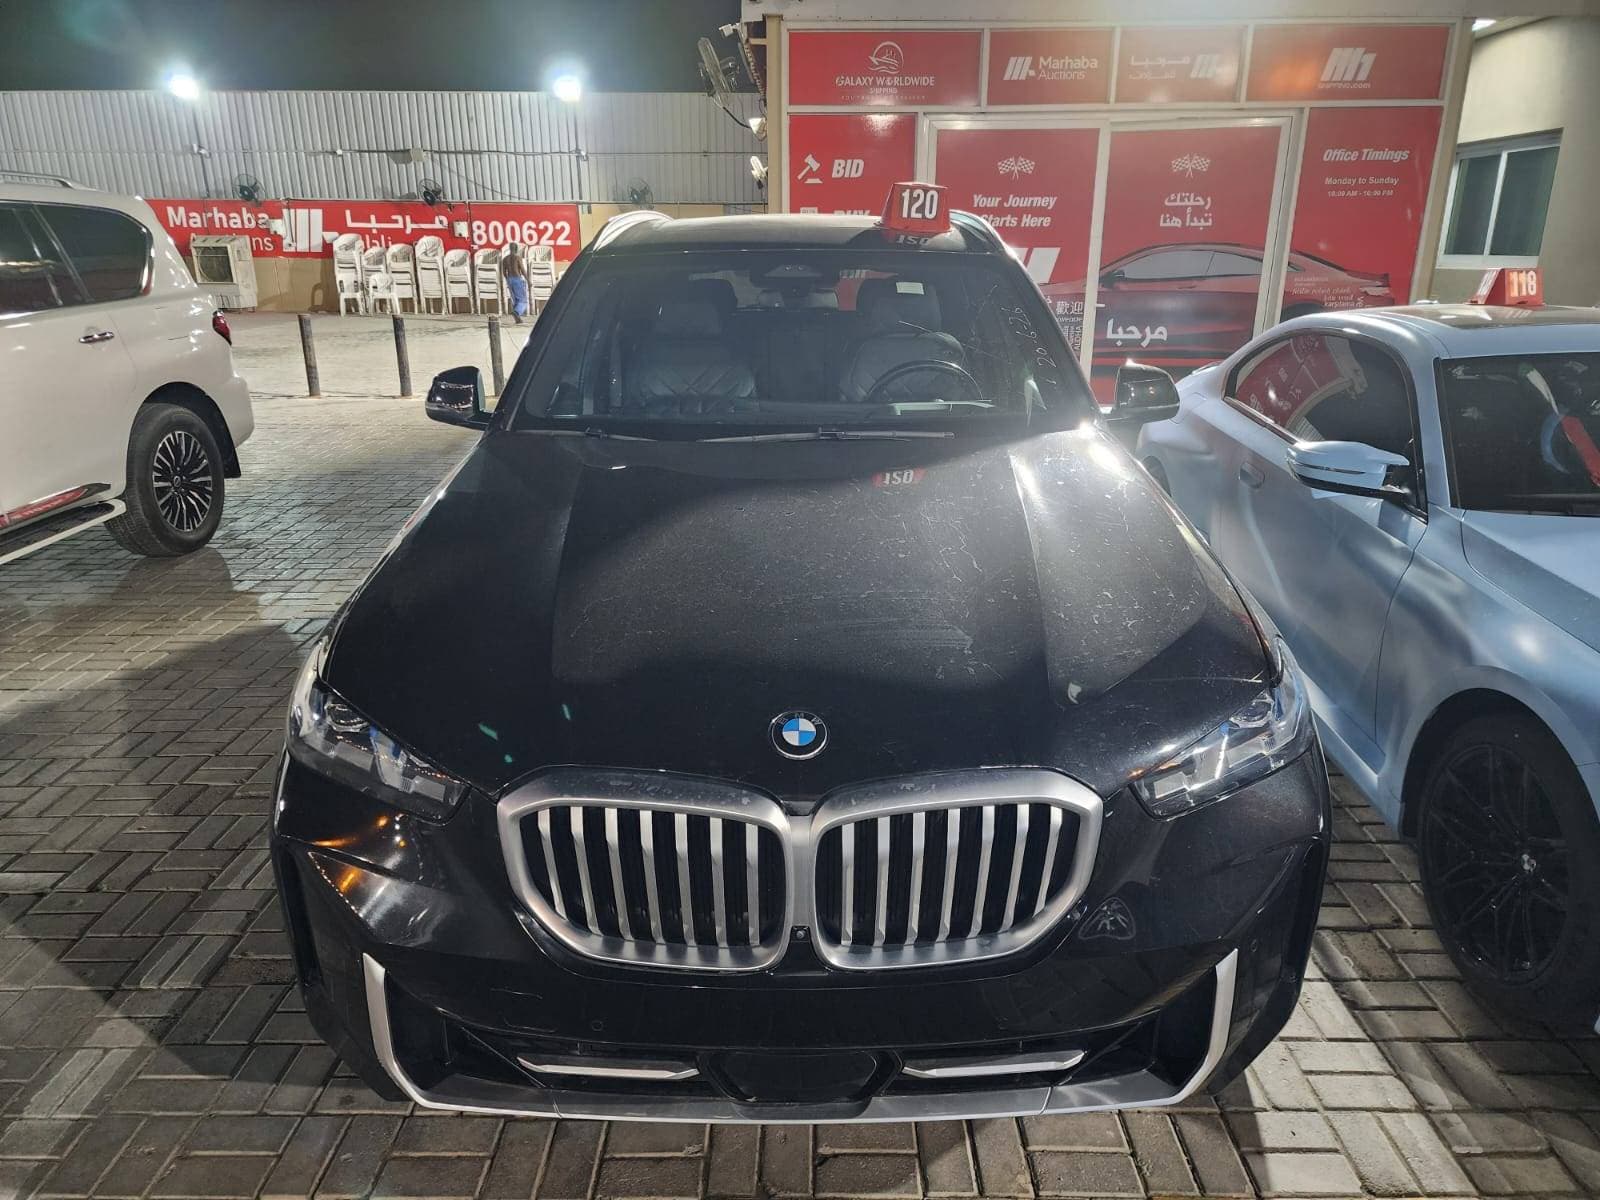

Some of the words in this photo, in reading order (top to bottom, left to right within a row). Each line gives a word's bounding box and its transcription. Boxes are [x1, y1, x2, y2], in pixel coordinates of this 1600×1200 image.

[1039, 55, 1098, 69] Marhaba
[835, 76, 874, 86] GALAXY
[1037, 70, 1086, 80] Auctions
[1323, 149, 1359, 162] Office
[1361, 148, 1410, 163] Timings
[831, 159, 865, 178] BID
[1324, 177, 1357, 186] Monday
[1368, 176, 1399, 186] Sunday
[901, 188, 939, 219] 120
[973, 194, 1001, 208] Your
[1003, 195, 1057, 210] Journey
[1164, 192, 1212, 210] رحلتك
[166, 206, 270, 229] Marhaba
[344, 209, 449, 235] مرحبا
[1020, 213, 1052, 228] Here
[1159, 213, 1182, 228] هنا
[1185, 207, 1212, 230] تبدأ
[471, 220, 573, 246] 800622
[1508, 270, 1537, 298] 118
[1106, 318, 1169, 349] مرحبا
